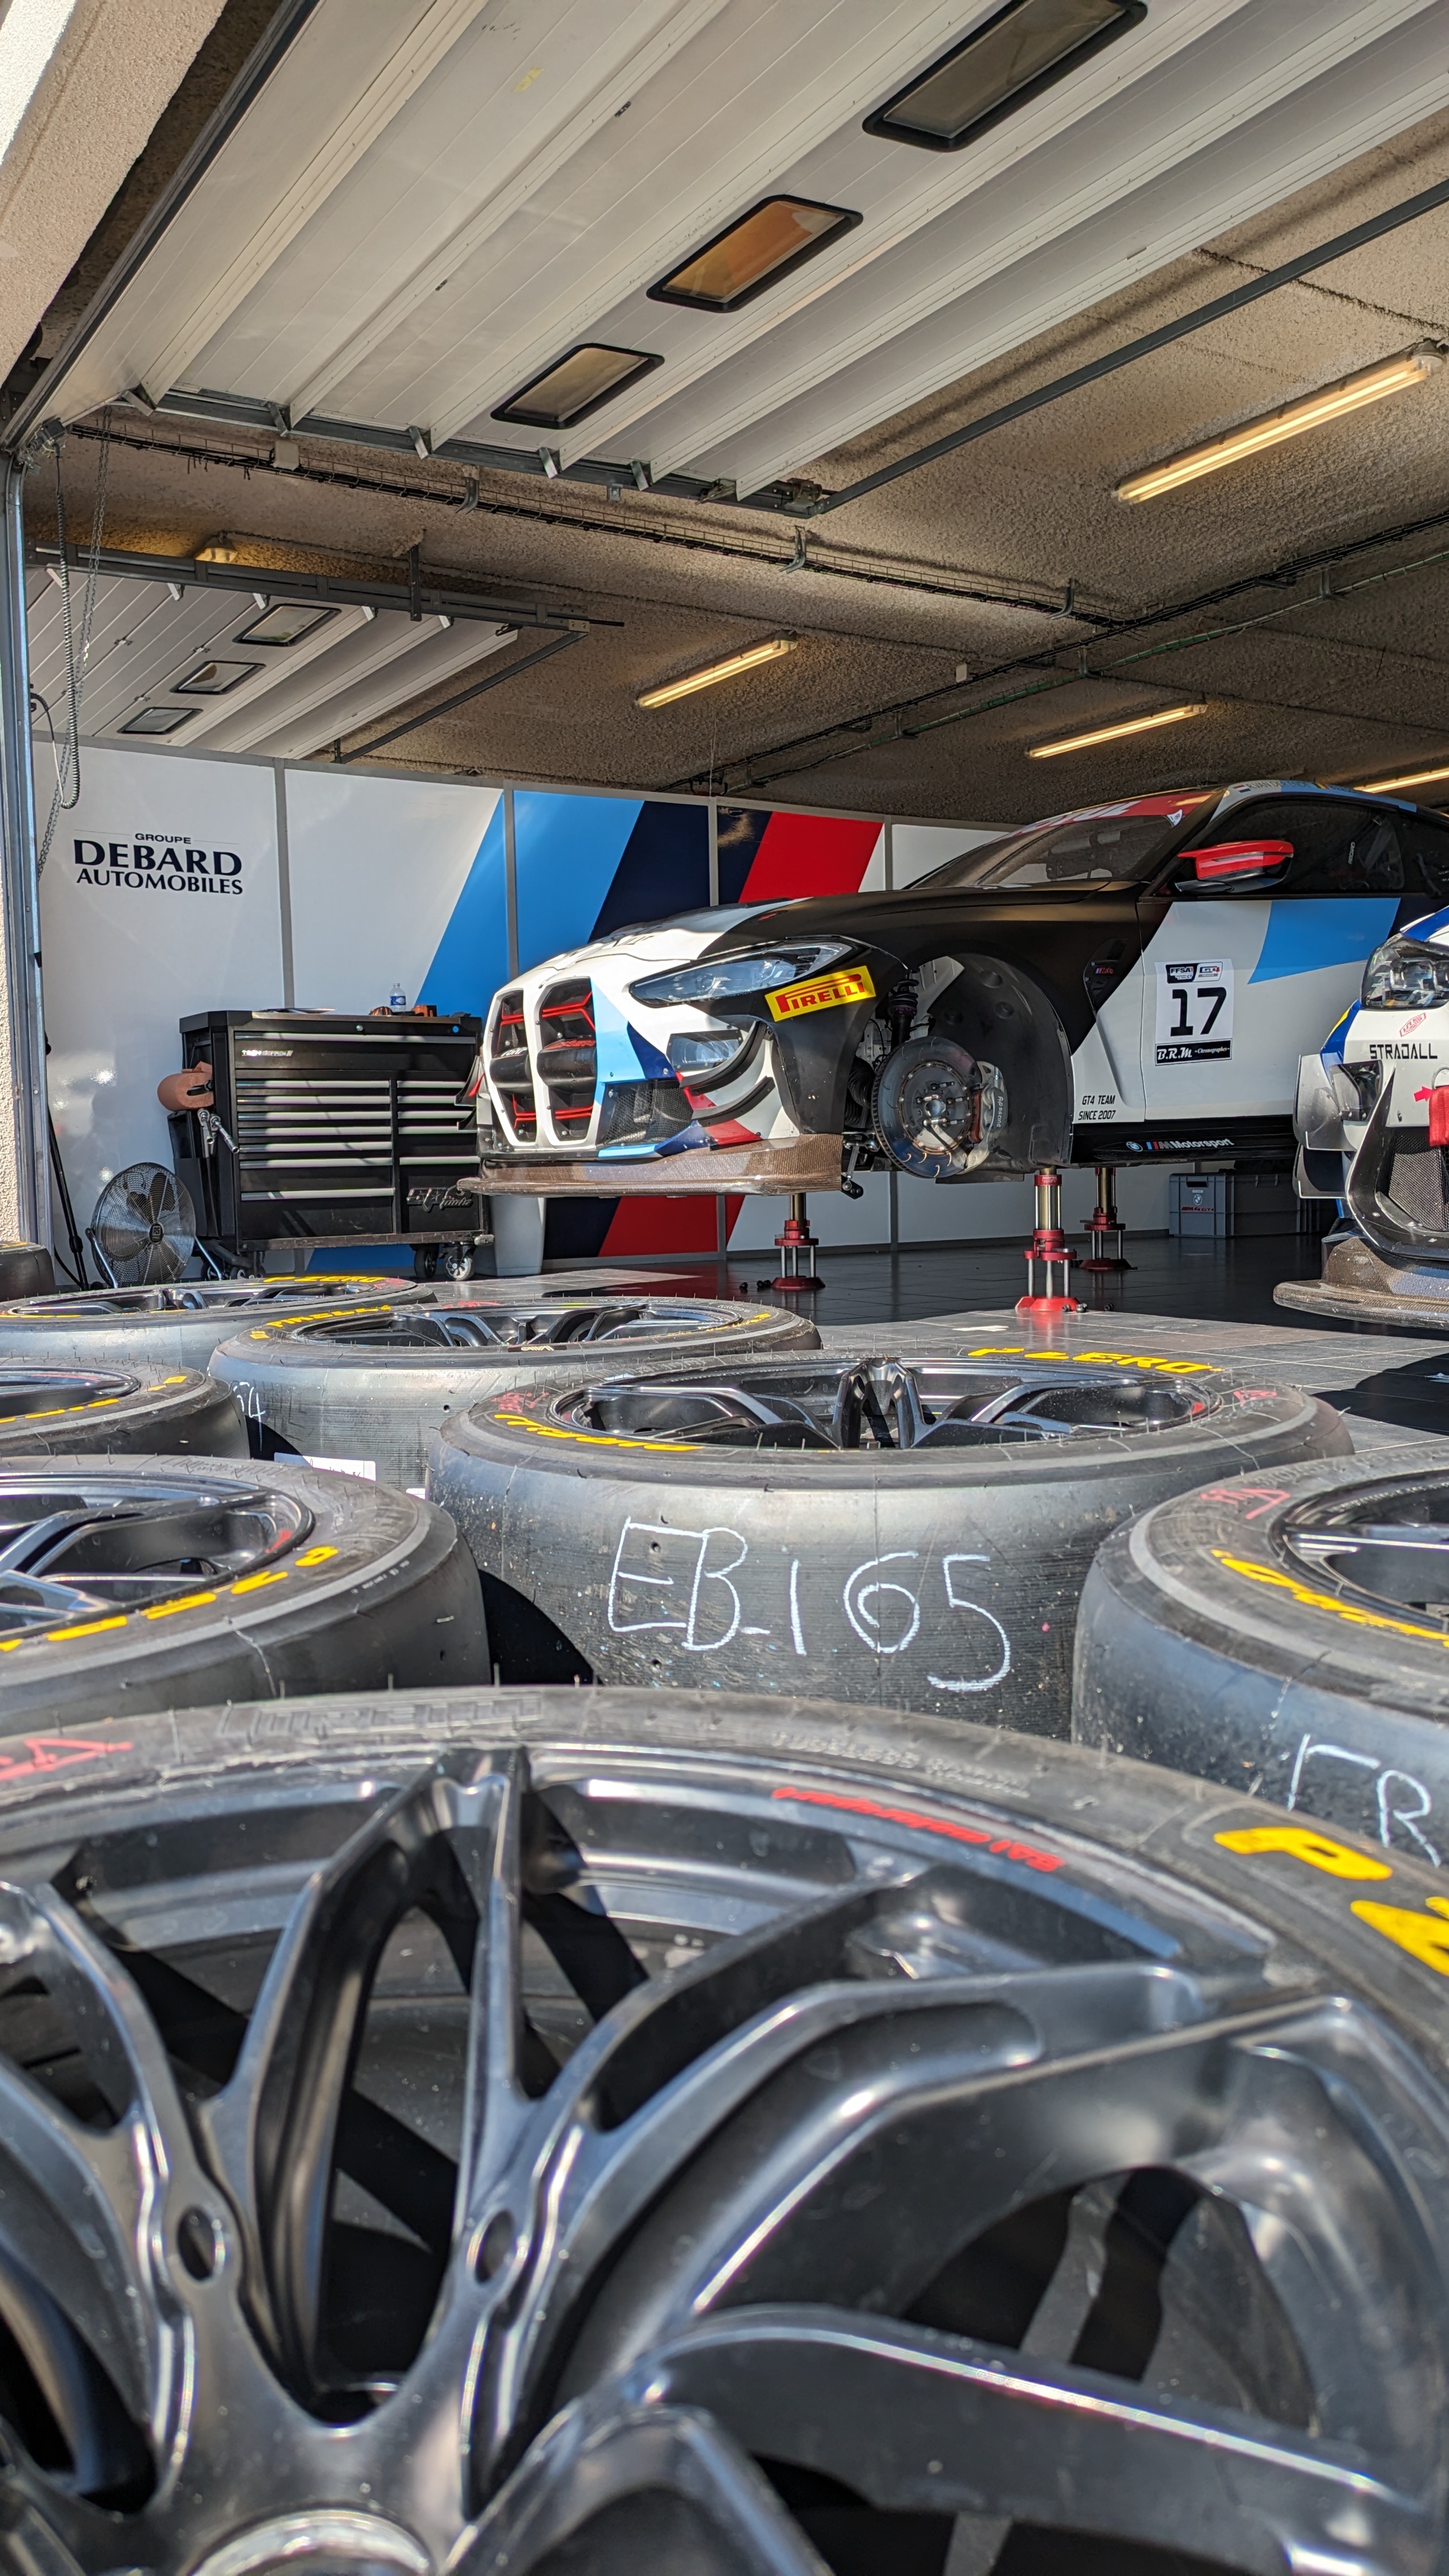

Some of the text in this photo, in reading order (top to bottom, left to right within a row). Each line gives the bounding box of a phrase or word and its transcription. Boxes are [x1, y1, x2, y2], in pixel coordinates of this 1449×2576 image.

[134, 832, 192, 845] GROUPE
[73, 839, 242, 876] DEBARD
[76, 868, 243, 895] AUTOMOBILES
[775, 973, 866, 1013] PIRELLI
[1170, 987, 1227, 1037] 17
[1157, 1047, 1193, 1061] B.R.M
[1369, 1043, 1438, 1059] STRADALL
[1082, 1095, 1116, 1105] GT4 TEAM
[1078, 1110, 1116, 1121] SINCE 2007
